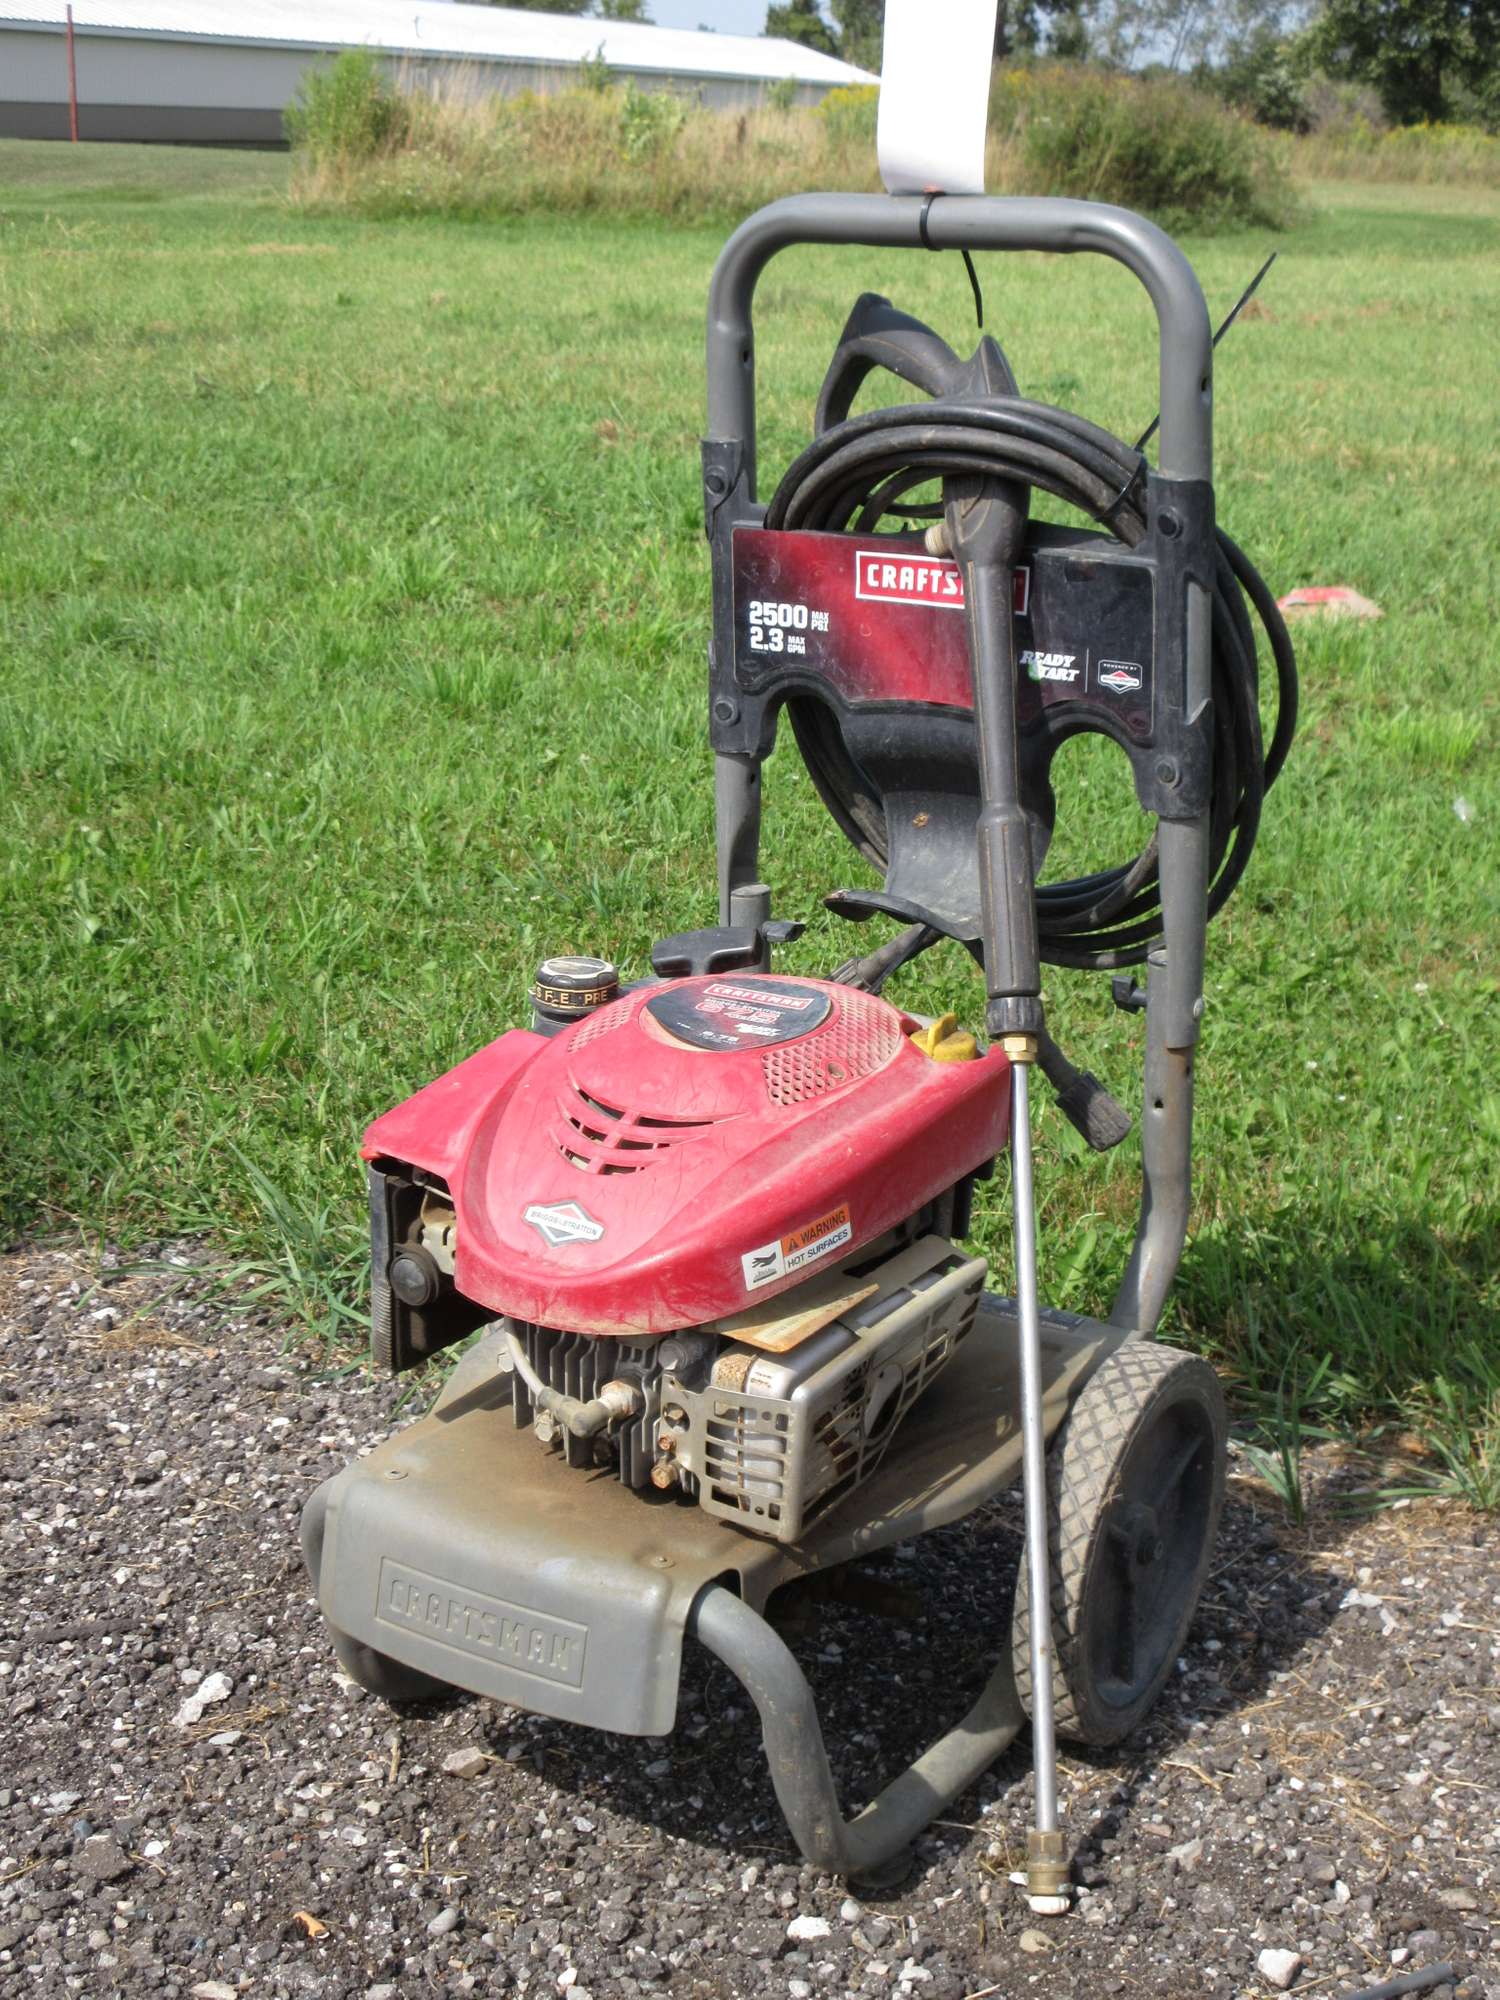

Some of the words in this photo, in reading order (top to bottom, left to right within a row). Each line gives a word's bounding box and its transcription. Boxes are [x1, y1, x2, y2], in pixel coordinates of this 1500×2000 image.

[866, 563, 964, 597] CRAFTS
[749, 600, 808, 629] 2500
[811, 610, 829, 621] MAX
[810, 620, 829, 632] PSI
[750, 625, 784, 652] 2.3
[787, 634, 806, 645] MAX
[787, 644, 806, 655] GPM
[1020, 650, 1076, 668] READY
[712, 988, 807, 1009] CRAFTSMAN
[800, 1210, 846, 1243] WARNING
[787, 1253, 806, 1269] HOT
[807, 1229, 848, 1258] SURFACES
[390, 1579, 570, 1671] CRAFTSMAN
